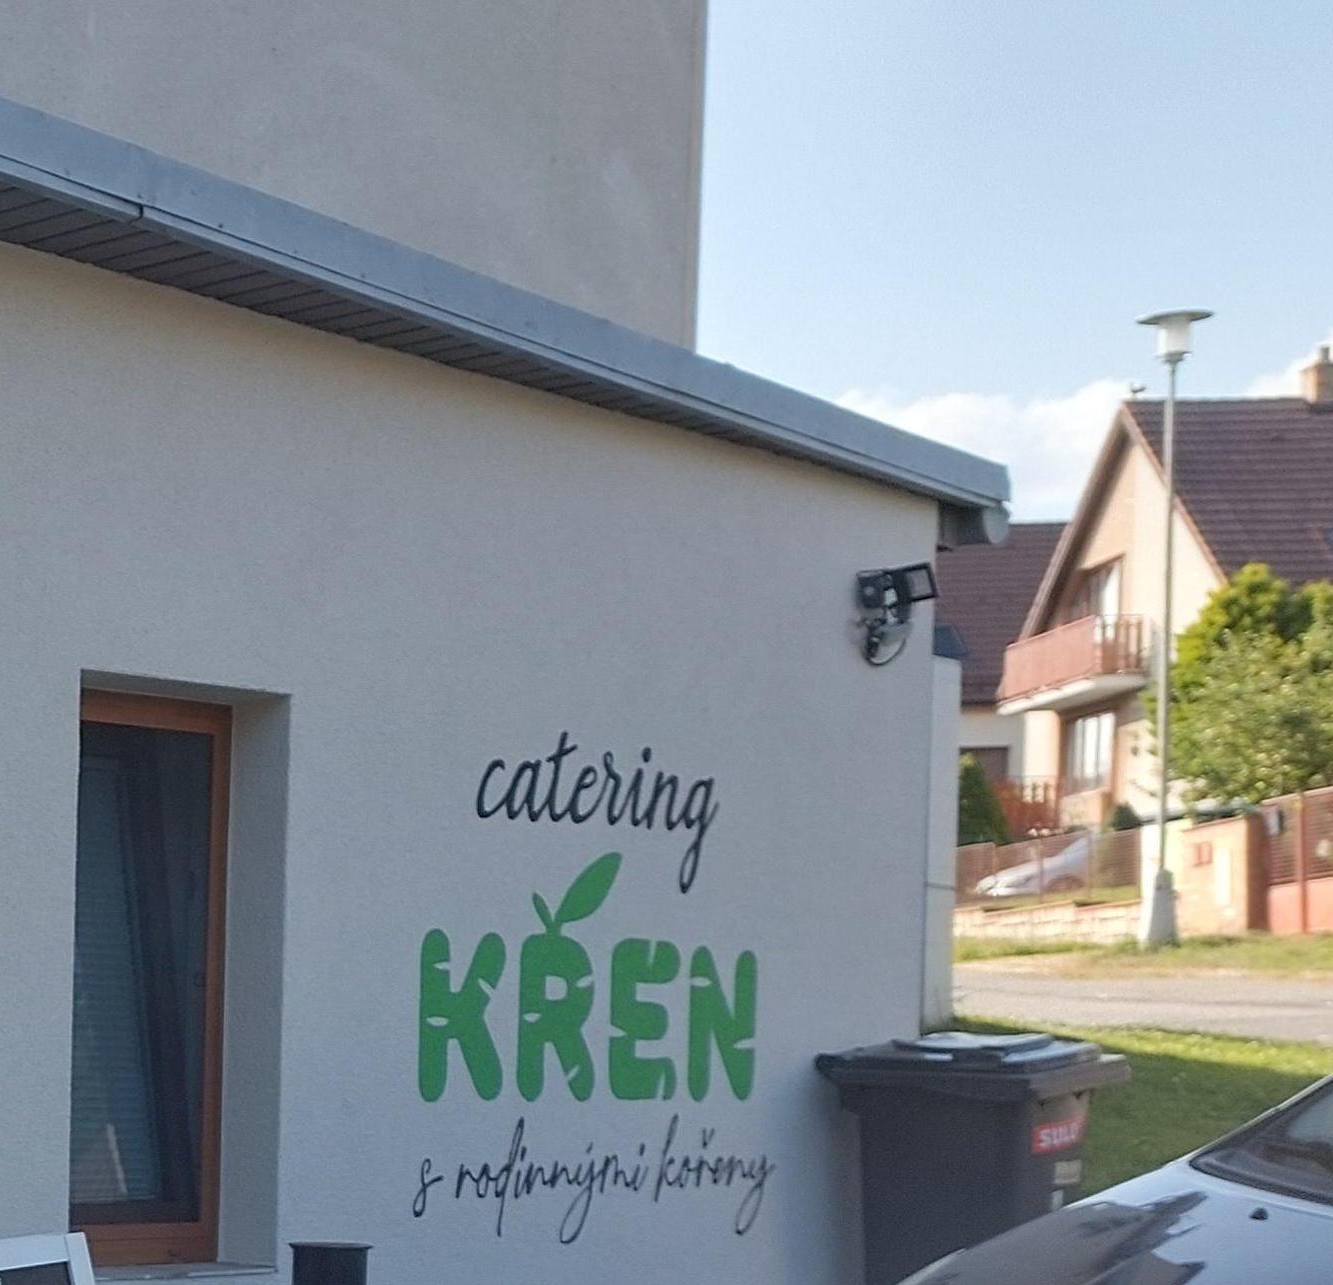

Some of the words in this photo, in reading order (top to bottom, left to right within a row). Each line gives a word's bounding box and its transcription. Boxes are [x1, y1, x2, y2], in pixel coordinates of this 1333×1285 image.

[475, 730, 720, 894] catering
[412, 1156, 443, 1218] s
[455, 1115, 648, 1244] rodinnými
[654, 1112, 776, 1236] kořeny
